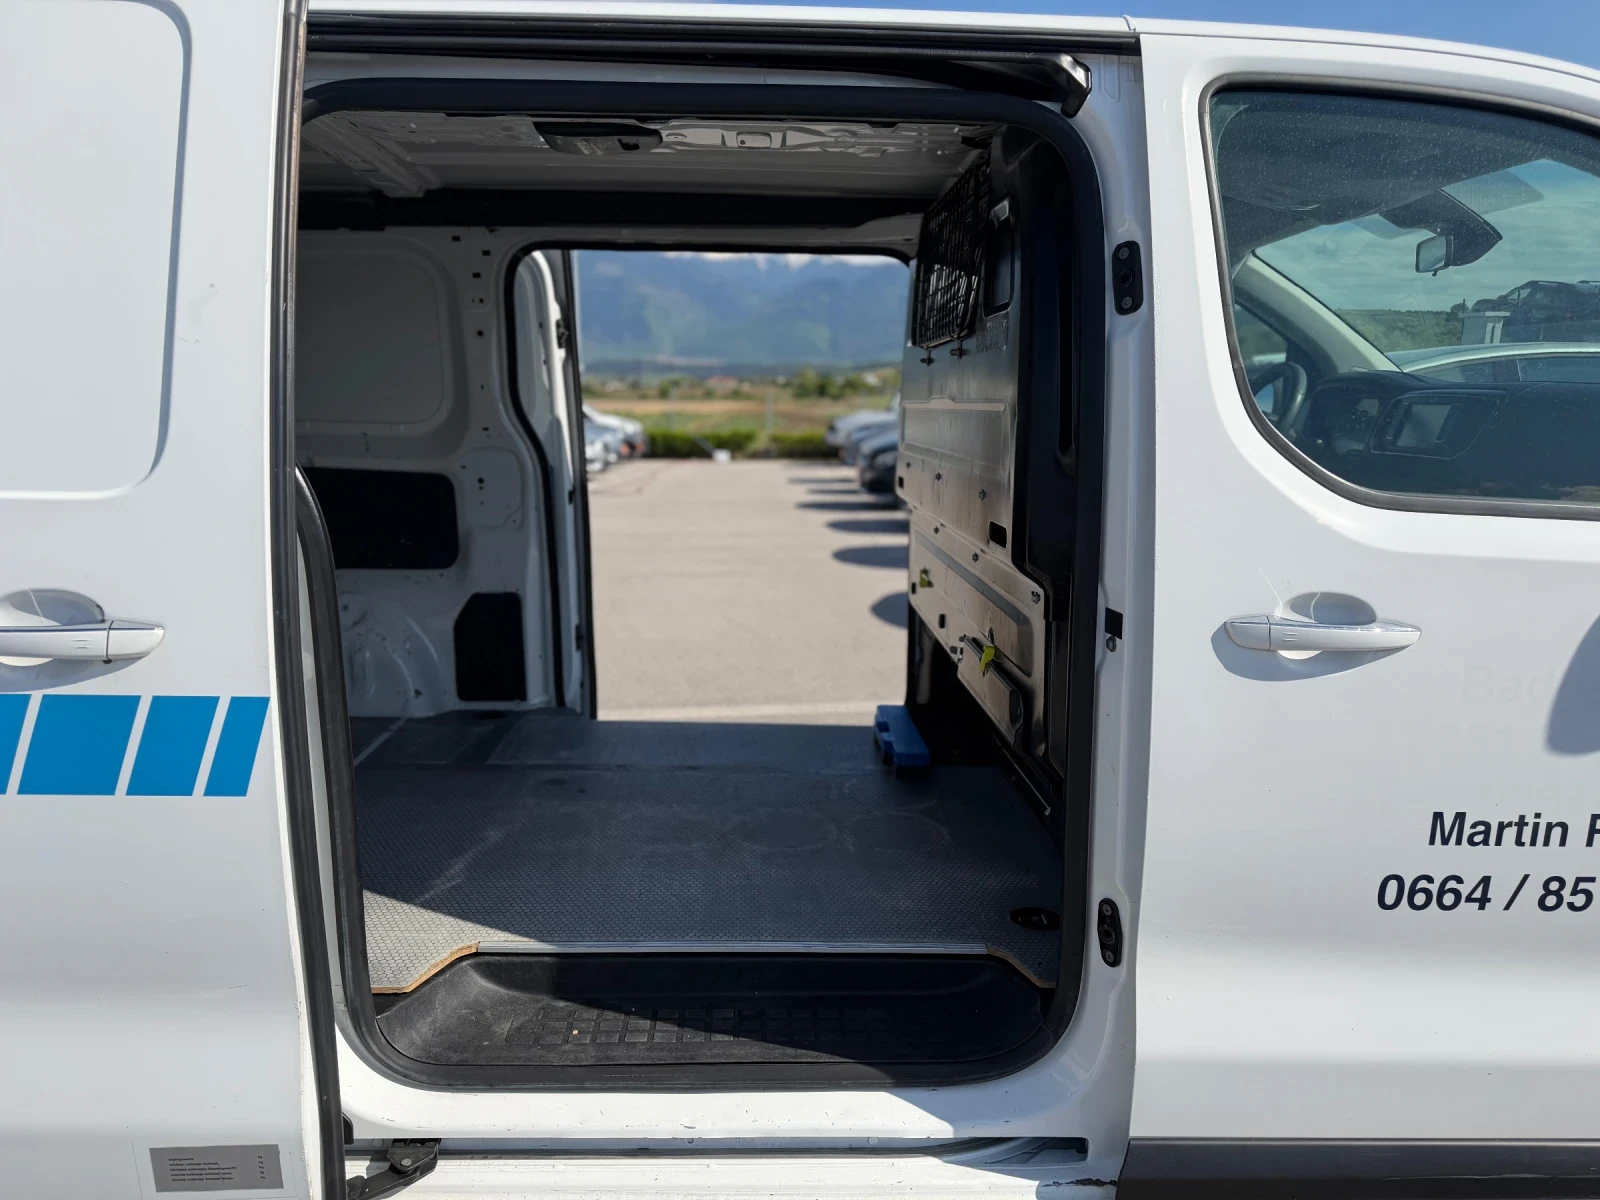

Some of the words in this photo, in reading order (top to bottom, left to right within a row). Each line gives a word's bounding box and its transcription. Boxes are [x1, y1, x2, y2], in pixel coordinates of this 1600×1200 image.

[1428, 811, 1569, 847] Martin
[1377, 873, 1492, 911] 0664
[1502, 873, 1531, 911] /
[1537, 875, 1597, 912] 85
